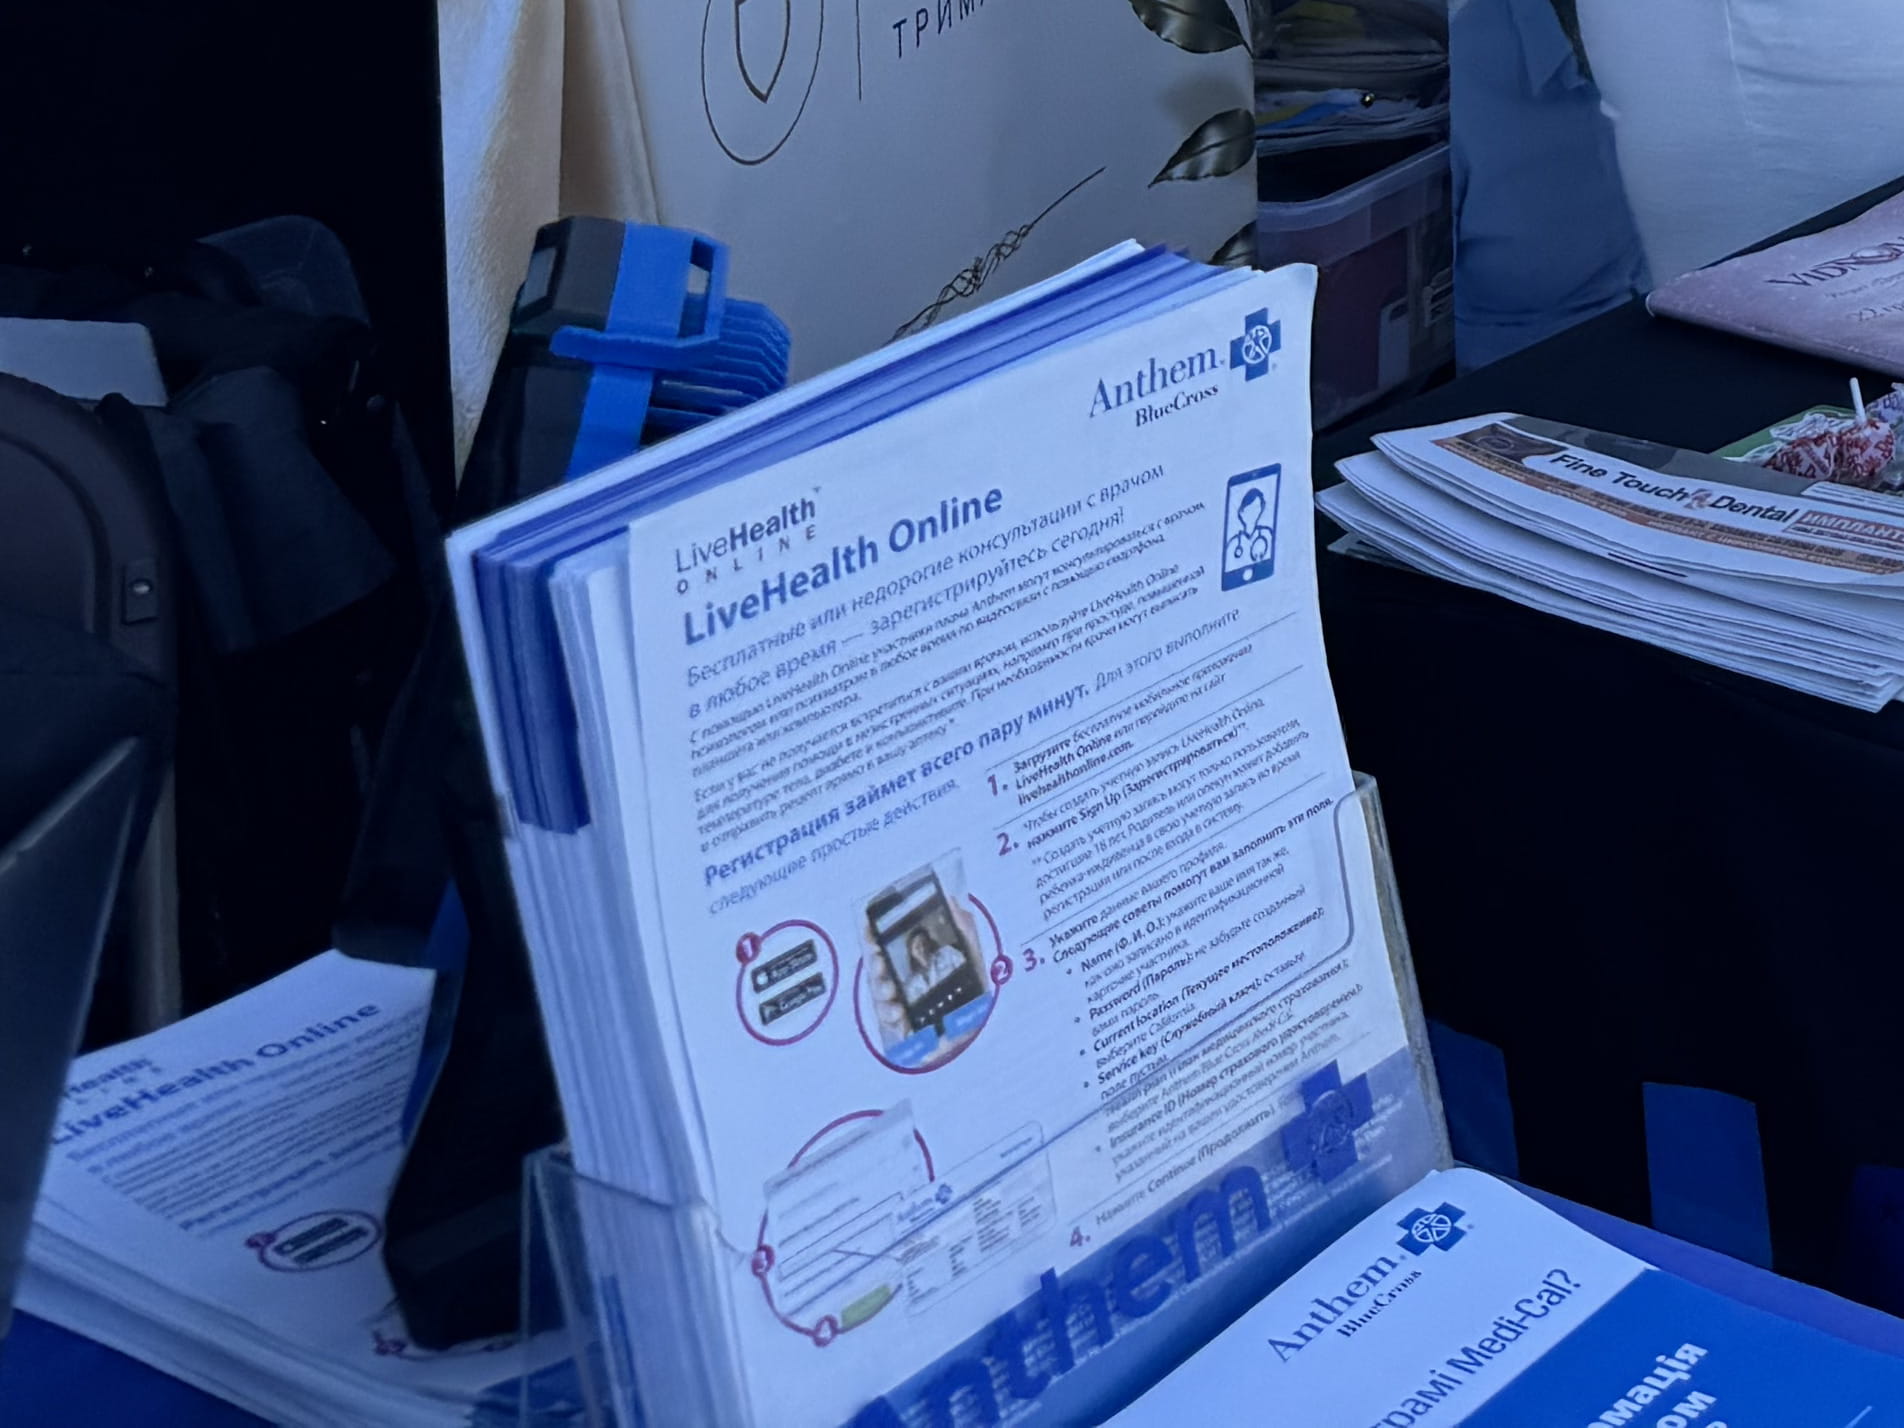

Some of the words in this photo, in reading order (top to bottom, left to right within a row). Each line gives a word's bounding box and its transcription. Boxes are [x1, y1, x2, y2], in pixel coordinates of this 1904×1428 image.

[1090, 347, 1219, 418] Anthem
[1136, 385, 1219, 428] BlueCross
[1549, 451, 1608, 481] Fine
[1611, 471, 1689, 503] Touch
[1709, 492, 1800, 524] Dental
[676, 498, 815, 574] LiveHealth
[684, 535, 878, 646] LiveHealth
[888, 487, 1003, 553] Online
[850, 552, 955, 617] недорогие
[957, 497, 1082, 568] консультации
[1099, 462, 1164, 506] врачом
[704, 804, 841, 889] Регистрация
[843, 764, 917, 817] займет
[919, 738, 974, 778] всего
[977, 713, 1024, 753] пару
[1026, 680, 1090, 727] минут.
[256, 1004, 381, 1058] Online
[1266, 1253, 1400, 1364] Anthem
[1337, 1270, 1423, 1339] BlueCross
[1446, 1267, 1582, 1376] Medi-Cal?
